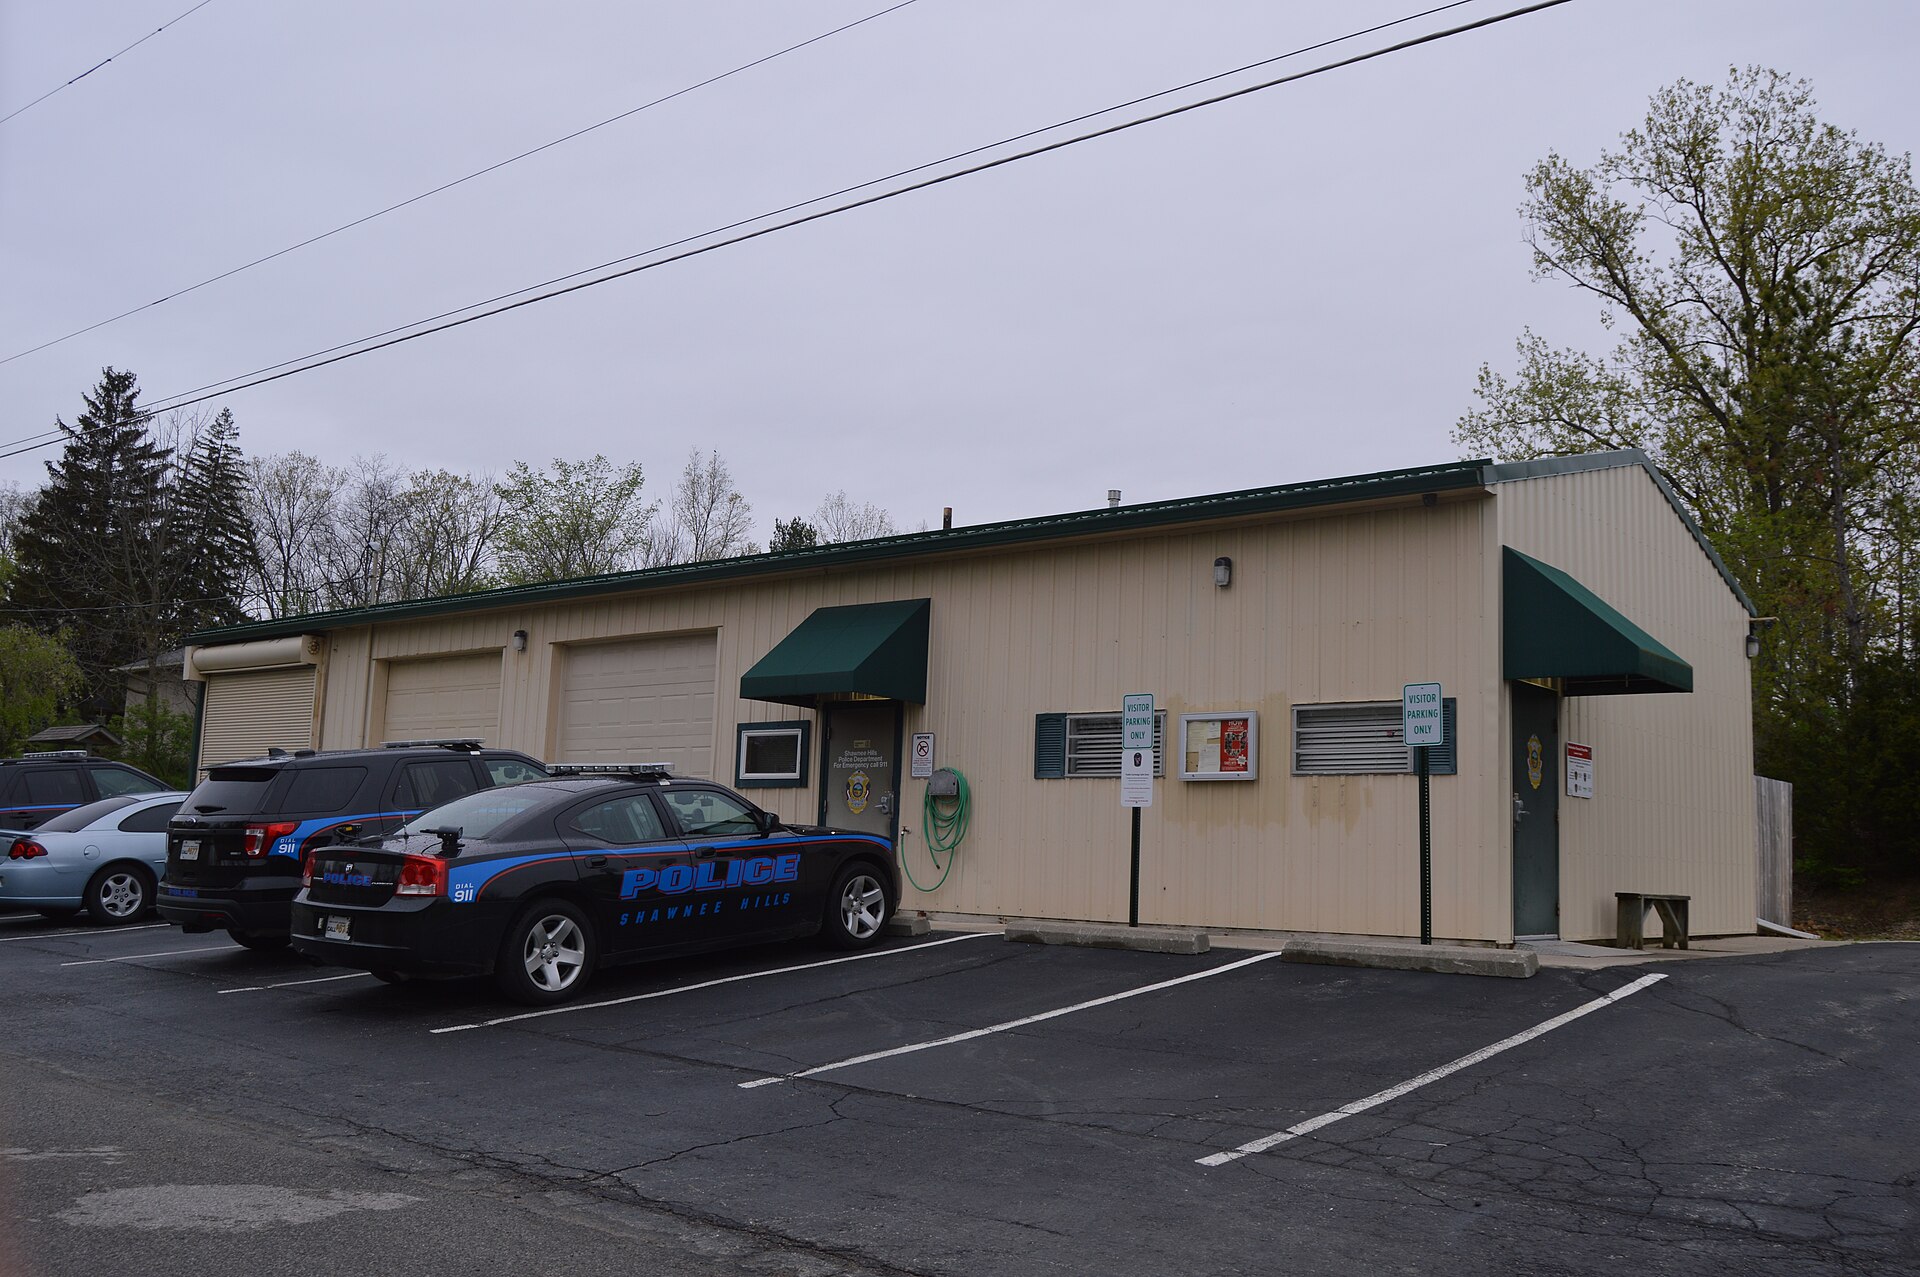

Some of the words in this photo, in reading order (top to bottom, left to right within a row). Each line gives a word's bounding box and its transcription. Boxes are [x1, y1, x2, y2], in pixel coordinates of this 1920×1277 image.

[1408, 693, 1437, 704] VISITOR
[1127, 703, 1150, 712] VISITOR
[1407, 709, 1438, 719] PARKING
[1125, 717, 1151, 726] PARKING
[1413, 724, 1432, 735] ONLY
[1130, 731, 1146, 740] ONLY
[278, 843, 296, 854] 911
[323, 872, 372, 887] POLICE
[619, 852, 801, 900] POLICE
[455, 882, 474, 890] DIAL
[454, 889, 474, 902] 911
[619, 901, 723, 926] SHAWNEE
[740, 893, 791, 911] HILLS
